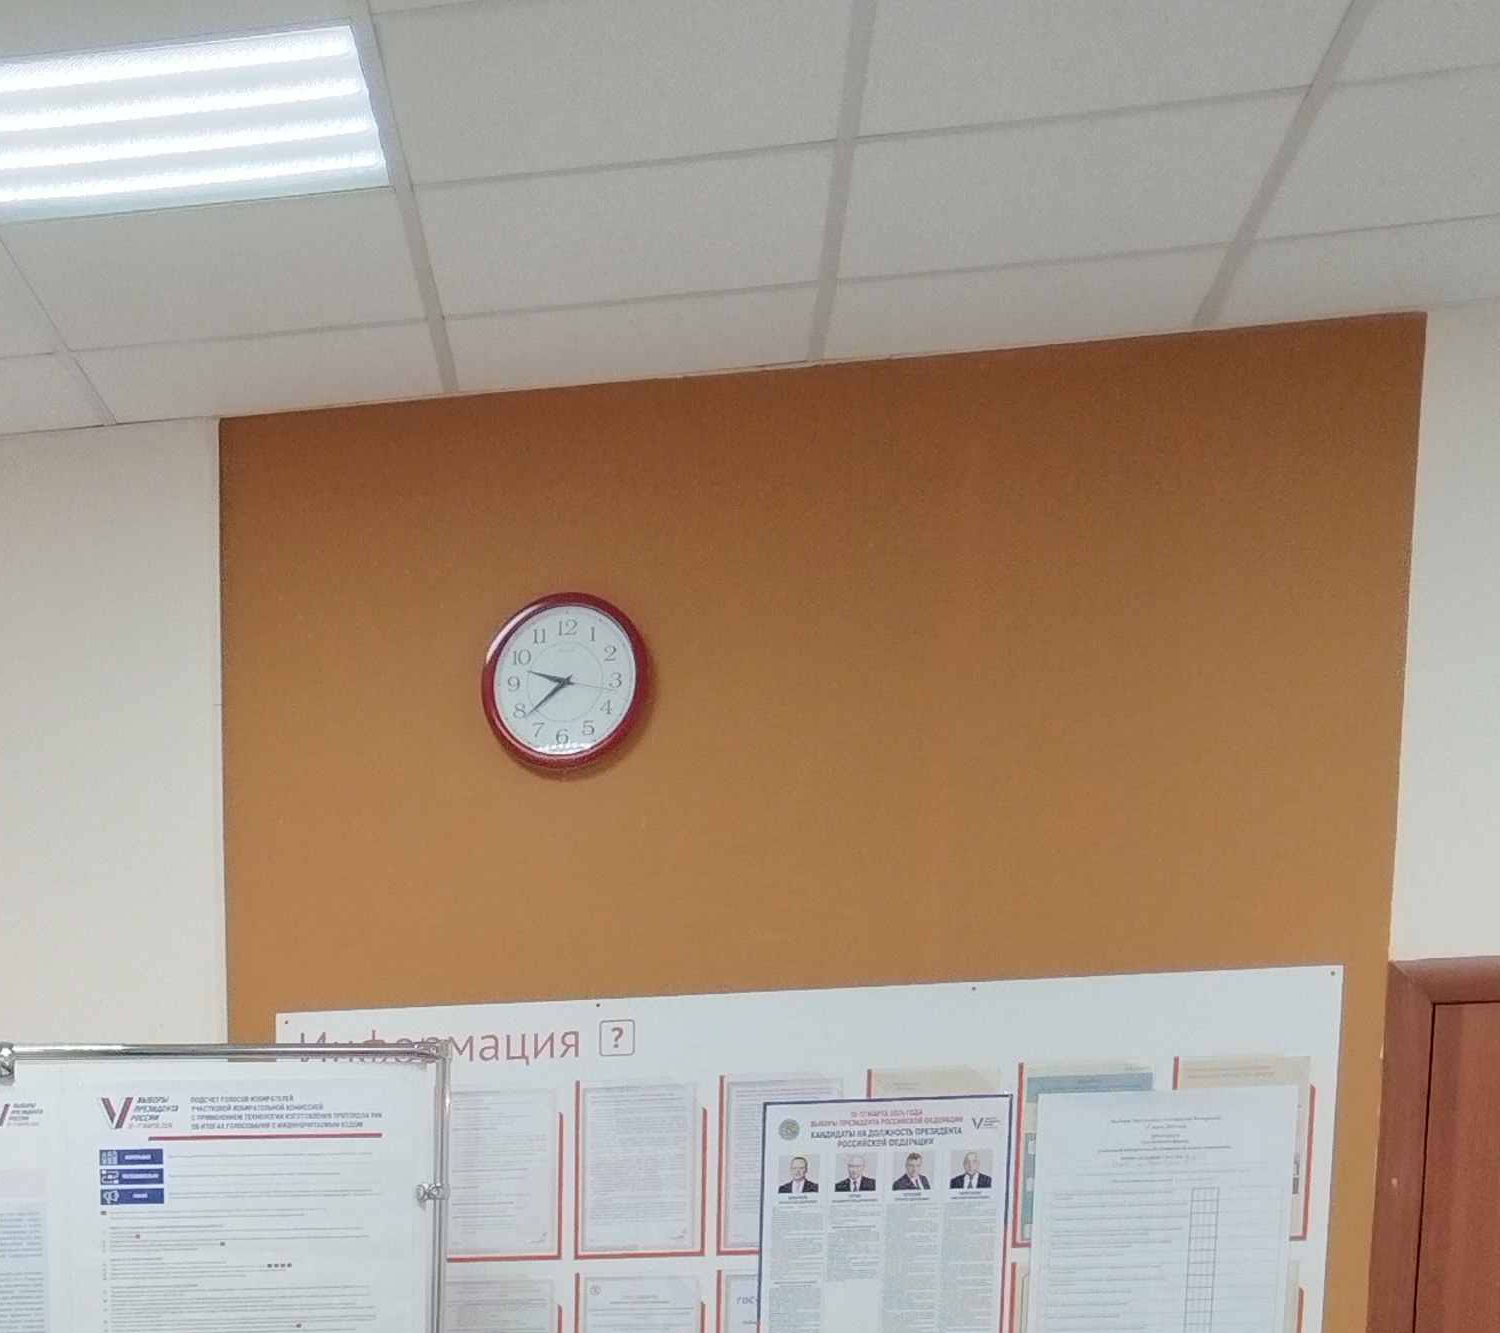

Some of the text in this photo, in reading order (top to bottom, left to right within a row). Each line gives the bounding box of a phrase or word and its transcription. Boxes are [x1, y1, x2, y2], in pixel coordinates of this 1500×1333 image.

[558, 620, 578, 636] 12
[590, 627, 596, 642] 1
[533, 628, 546, 644] 11
[512, 650, 531, 666] 10
[604, 646, 617, 662] 2
[507, 676, 520, 692] 9
[609, 673, 622, 688] 3
[513, 703, 528, 718] 8
[600, 700, 613, 715] 4
[532, 723, 545, 738] 7
[582, 721, 595, 735] 5
[556, 729, 569, 744] 6
[136, 1096, 169, 1104] ВЫБОРЫ
[190, 1096, 220, 1104] ПОДСЧЕТ
[251, 1095, 294, 1103] ИЗБИРАТЕЛЕЙ
[191, 1102, 324, 1112] УЧАСТКОВОЙ ИЗБИРАТЕЛЬНОЙ КОМИССИЕЙ
[133, 1105, 179, 1113] ПРЕЗИДЕНТА
[245, 1113, 284, 1121] ТЕХНОЛОГИИ
[285, 1112, 331, 1120] ИЗГОТОВЛЕНИЯ
[130, 1114, 160, 1122] РОССИИ
[226, 1122, 270, 1130] ГОЛОСОВАНИЯ
[811, 1126, 962, 1140] КАНДИДАТЫ НА ДОЛЖНОСТЬ ПРЕЗИДЕНТА
[837, 1137, 935, 1148] РОССИЙСКОЙ ФЕДЕРАЦИИ
